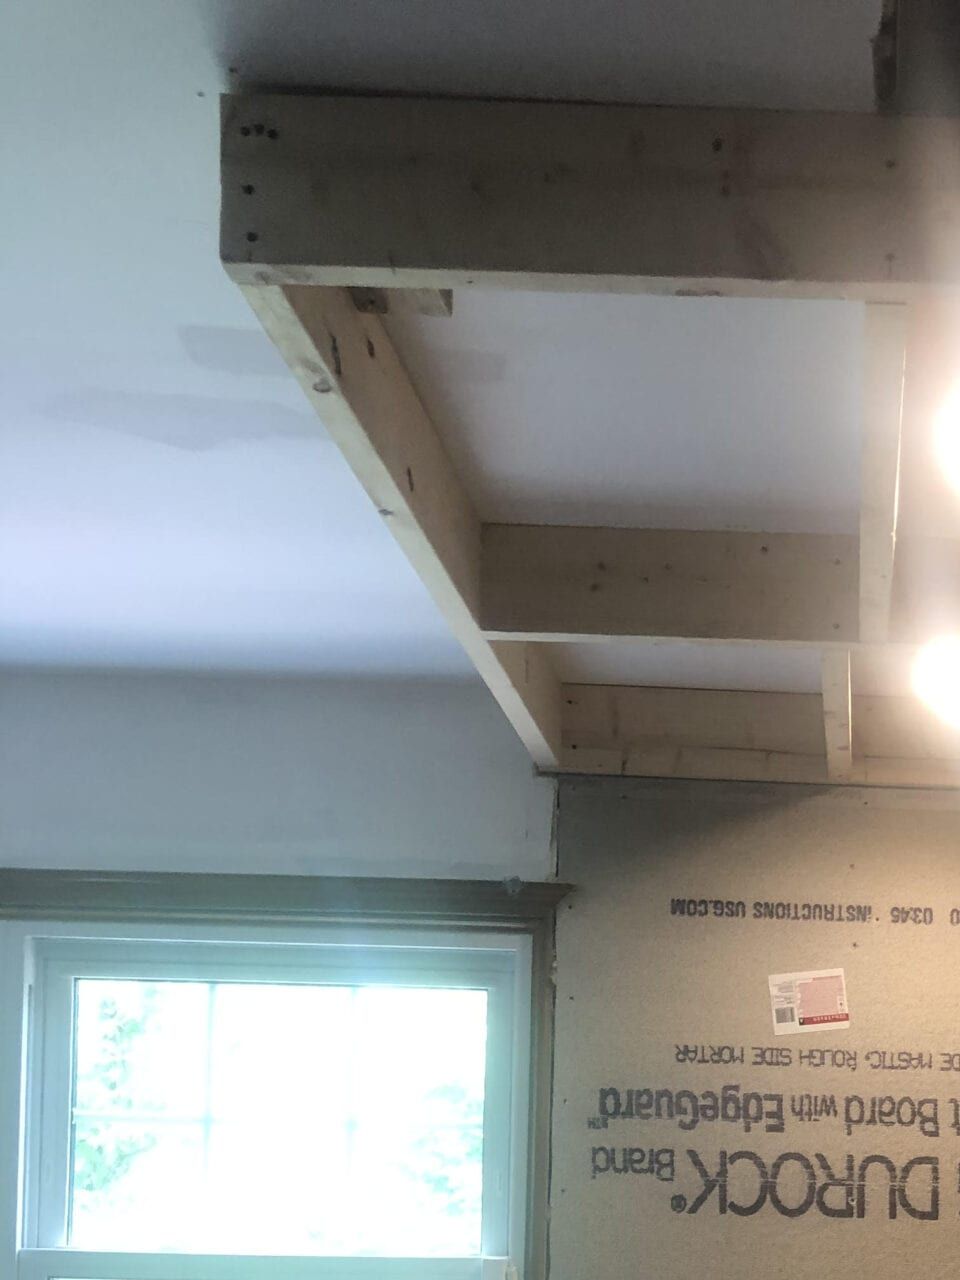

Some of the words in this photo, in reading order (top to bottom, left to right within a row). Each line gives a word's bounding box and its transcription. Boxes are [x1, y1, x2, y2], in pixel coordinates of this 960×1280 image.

[670, 898, 746, 918] USG.COM
[753, 901, 871, 922] INSTRUCTIONS
[673, 1044, 744, 1064] MORTAR
[752, 1047, 792, 1066] SIDE
[799, 1049, 857, 1070] ROUGH
[597, 1085, 784, 1133] EdgeGuard
[791, 1094, 838, 1122] with
[844, 1095, 940, 1137] Board
[591, 1147, 674, 1182] Brand
[685, 1149, 939, 1220] DUROCK
